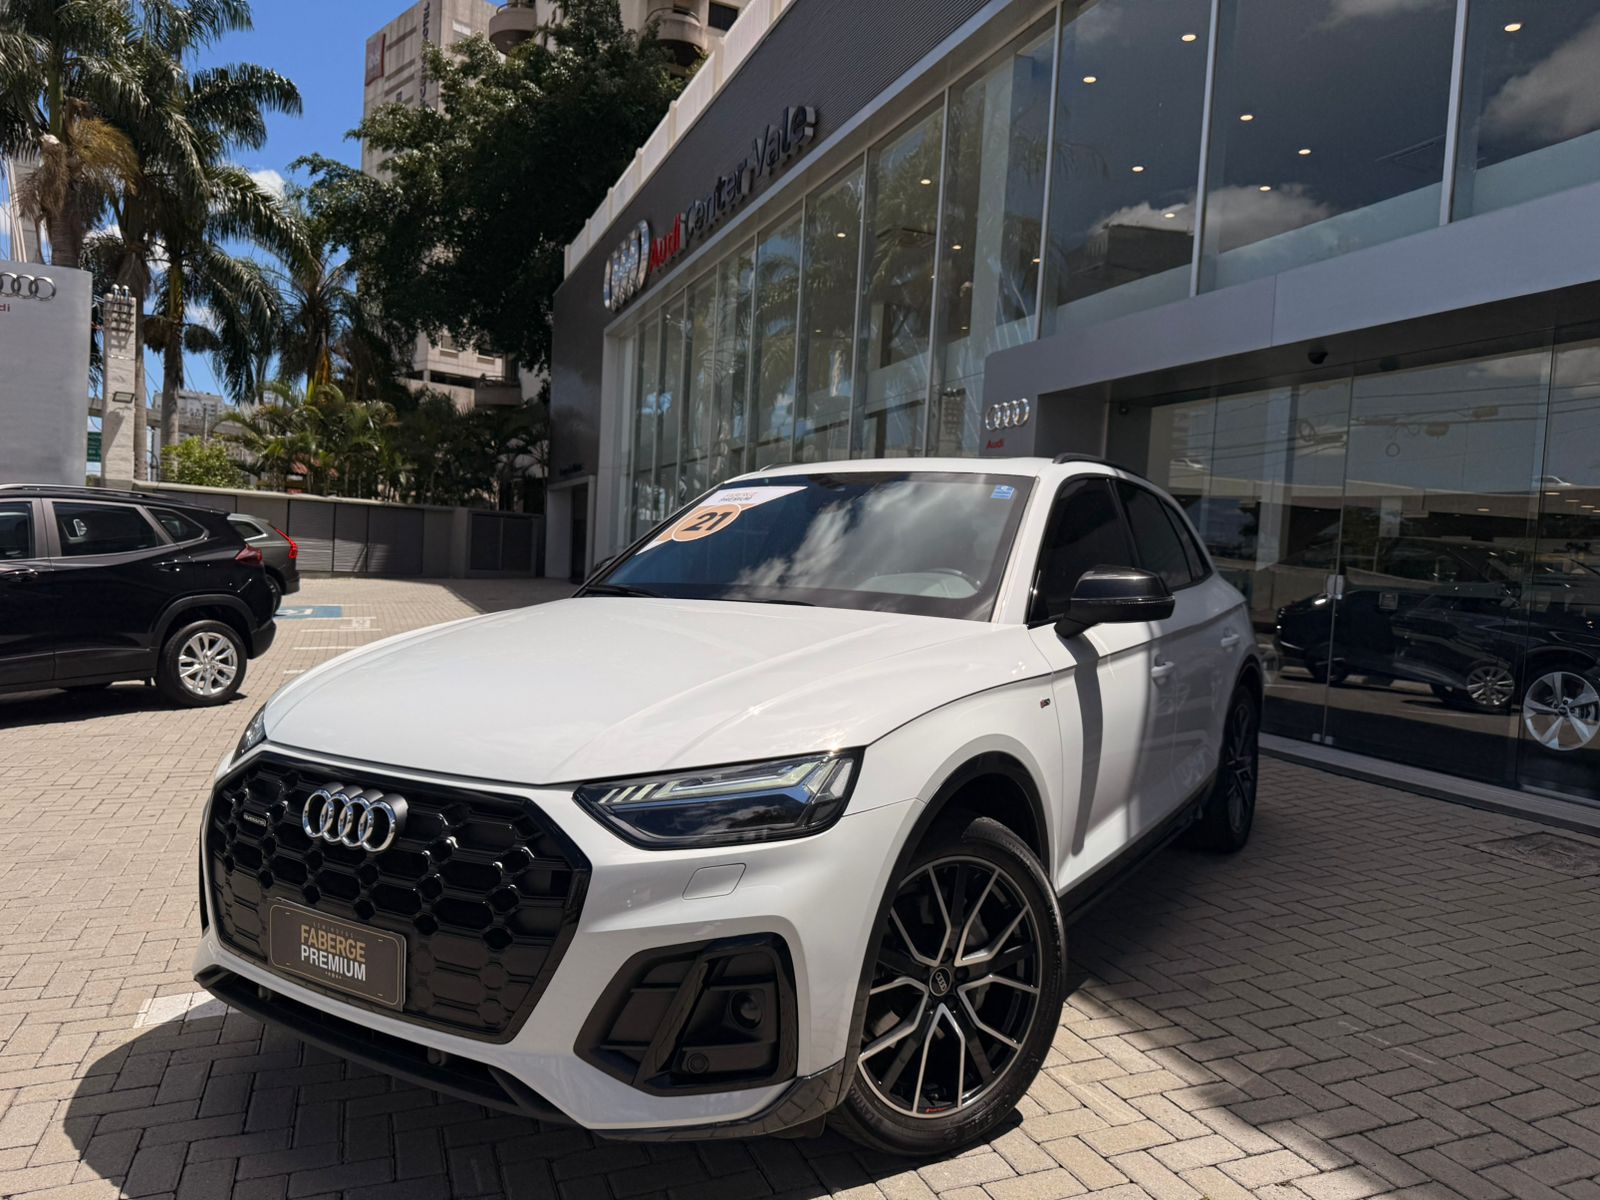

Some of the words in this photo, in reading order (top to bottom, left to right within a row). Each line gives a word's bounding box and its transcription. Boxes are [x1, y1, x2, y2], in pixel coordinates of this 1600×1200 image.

[649, 212, 684, 273] Audi
[684, 157, 752, 240] Center
[753, 105, 816, 179] Vale
[986, 439, 1004, 449] Audi
[681, 512, 732, 532] 21
[301, 924, 367, 963] FABERGE
[301, 944, 367, 982] PREMIUM
